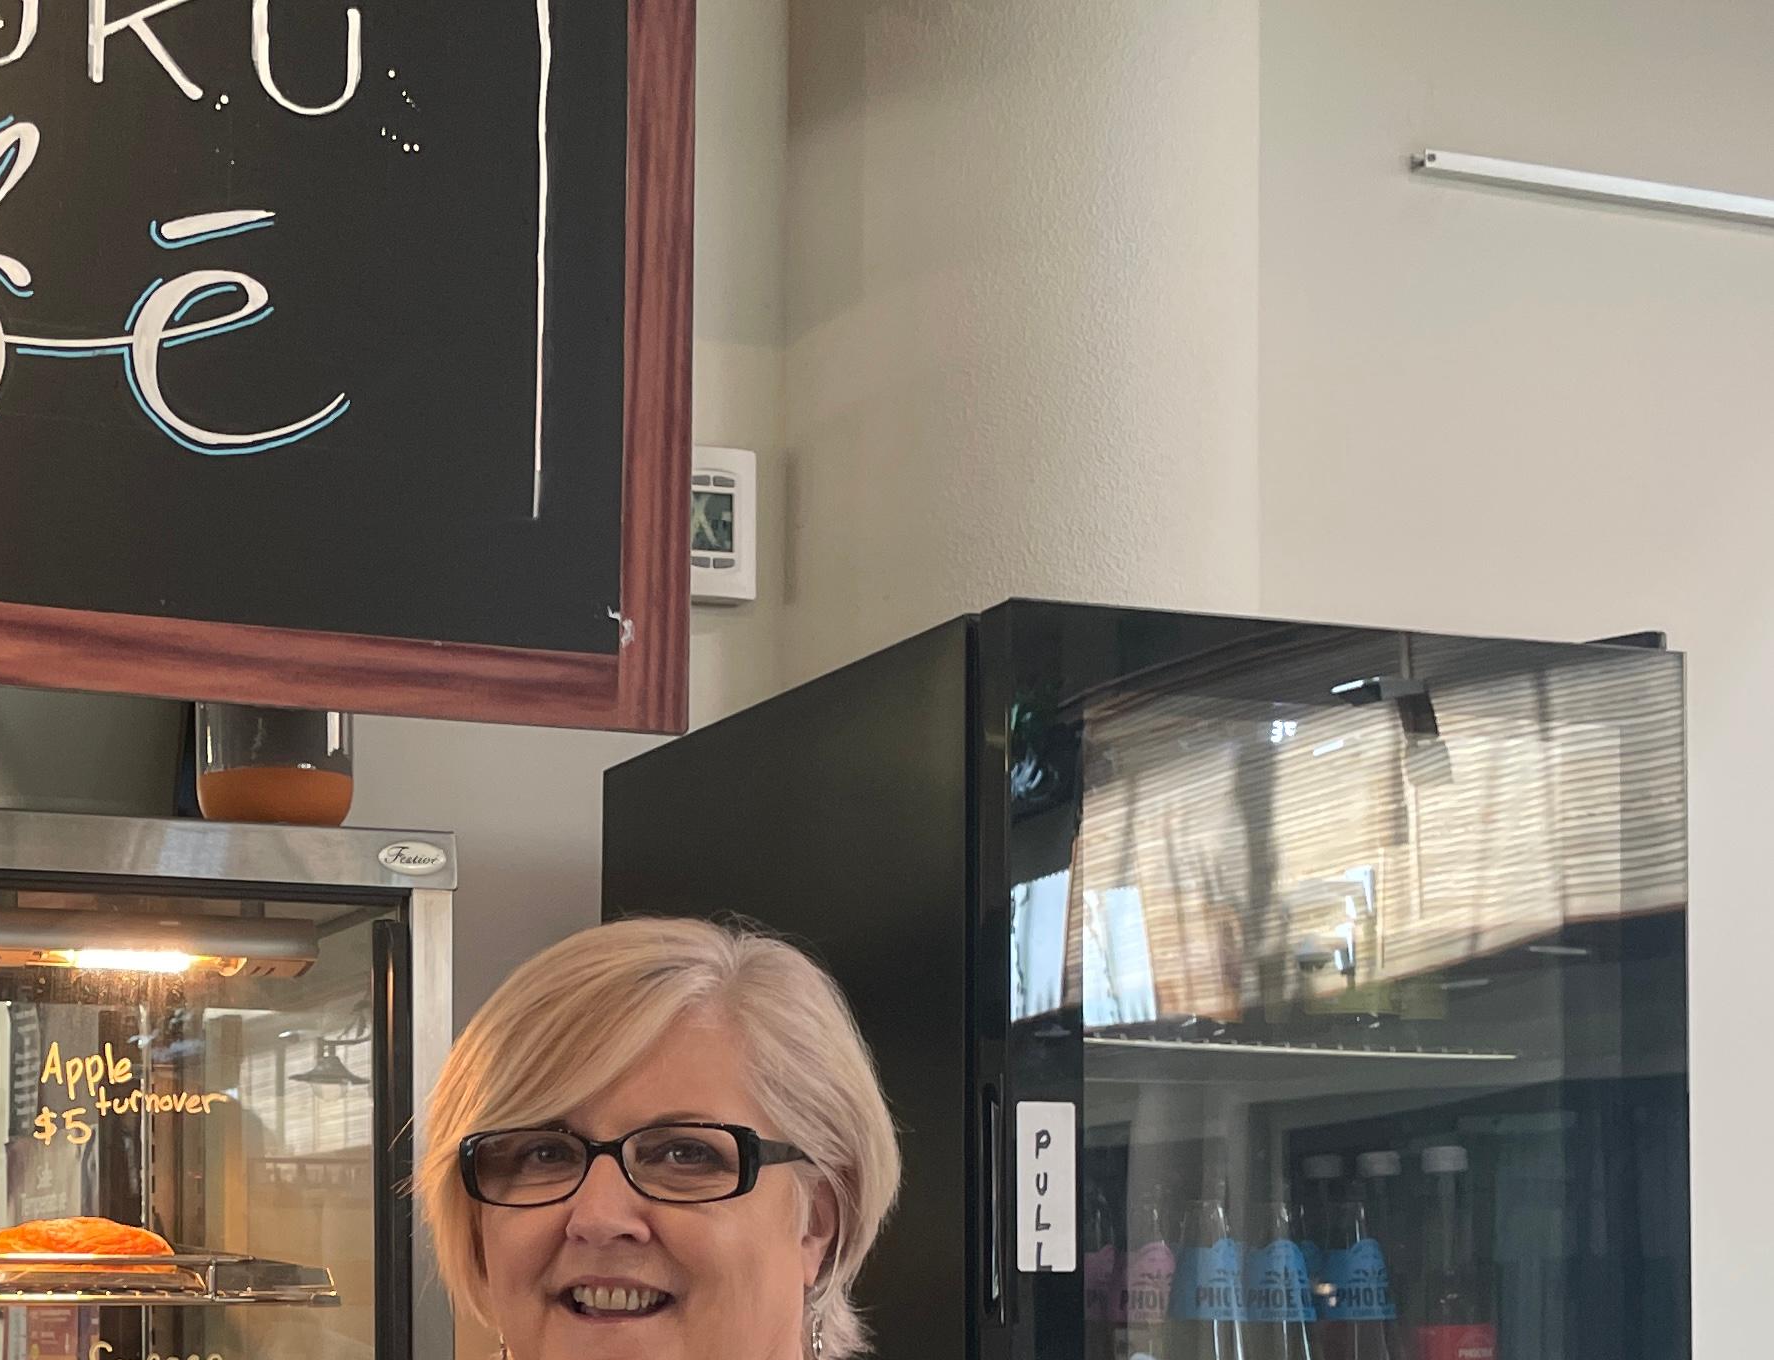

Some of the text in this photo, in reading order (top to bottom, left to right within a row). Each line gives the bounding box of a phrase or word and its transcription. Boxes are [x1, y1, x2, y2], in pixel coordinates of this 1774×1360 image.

[39, 1041, 133, 1100] Apple
[97, 1084, 227, 1120] turnover
[32, 1105, 93, 1145] $5
